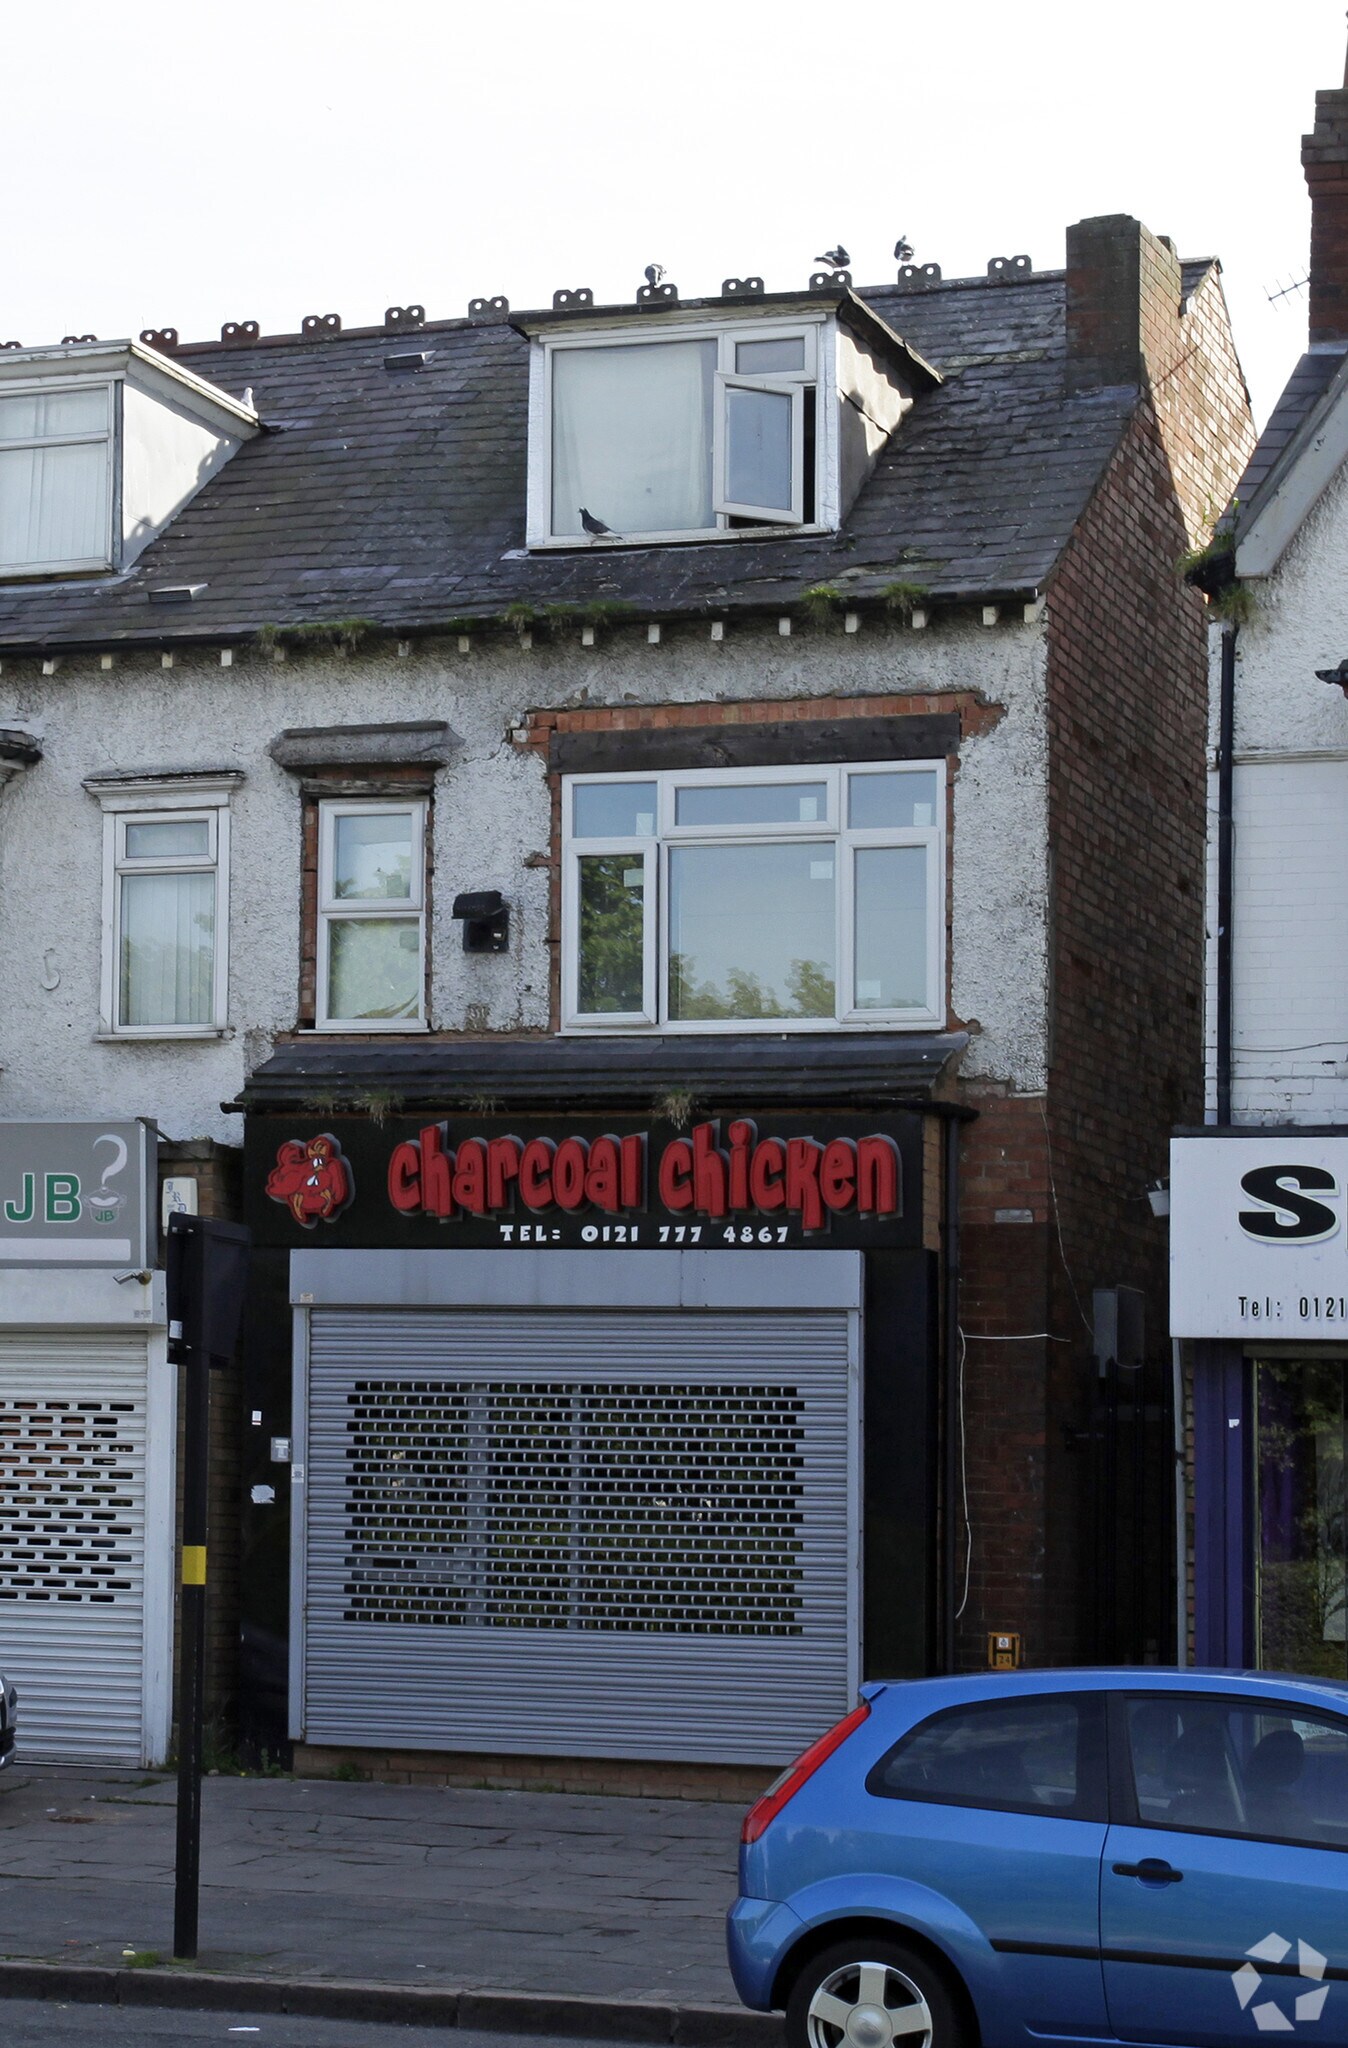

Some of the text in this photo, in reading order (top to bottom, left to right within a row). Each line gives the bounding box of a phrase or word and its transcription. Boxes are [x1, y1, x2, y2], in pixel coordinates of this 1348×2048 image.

[4, 1172, 83, 1223] JB
[388, 1119, 898, 1230] charcoal chicken
[1238, 1164, 1348, 1248] S
[500, 1225, 790, 1243] TEL: 0121 777 4867
[1238, 1296, 1282, 1318] Tel:
